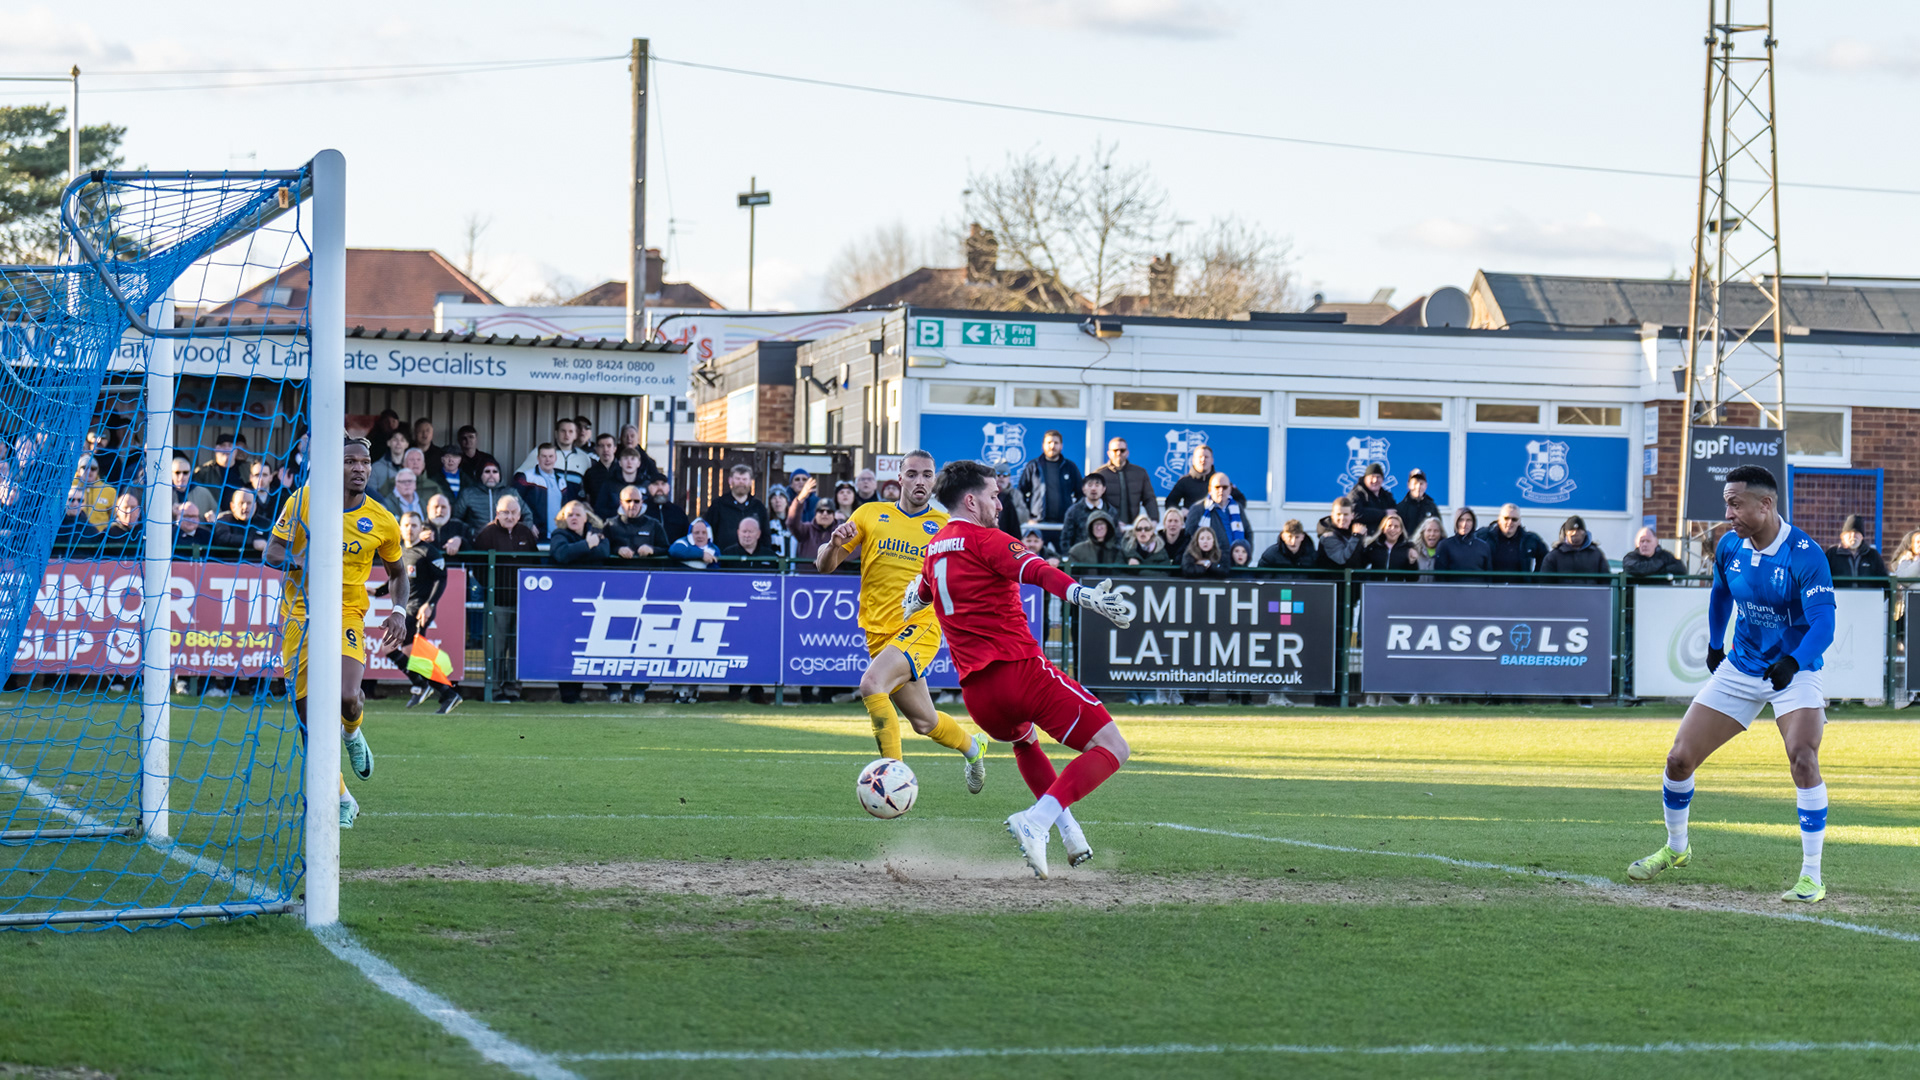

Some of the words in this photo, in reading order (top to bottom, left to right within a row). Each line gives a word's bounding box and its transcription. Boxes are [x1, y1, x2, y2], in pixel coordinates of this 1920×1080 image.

[920, 321, 940, 345] B
[1011, 325, 1032, 335] Fire
[1011, 336, 1031, 345] exit
[242, 343, 260, 365] &
[388, 350, 507, 377] Specialists
[552, 357, 568, 368] Tel:
[573, 358, 592, 369] 020
[596, 360, 624, 371] 8424
[627, 361, 655, 372] 0800
[529, 370, 676, 385] www.nagleflooring.co.uk
[878, 537, 919, 556] utilita
[934, 557, 954, 616] 1
[1111, 584, 1259, 625] SMITH
[185, 630, 233, 648] 8805
[345, 628, 357, 643] 6
[1109, 629, 1304, 668] LATIMER
[571, 657, 728, 679] SCAFFOLDING
[729, 659, 749, 669] LTD
[1500, 654, 1588, 666] BARBERSHOP
[1109, 669, 1303, 685] www.smithandlatimer.co.uk
